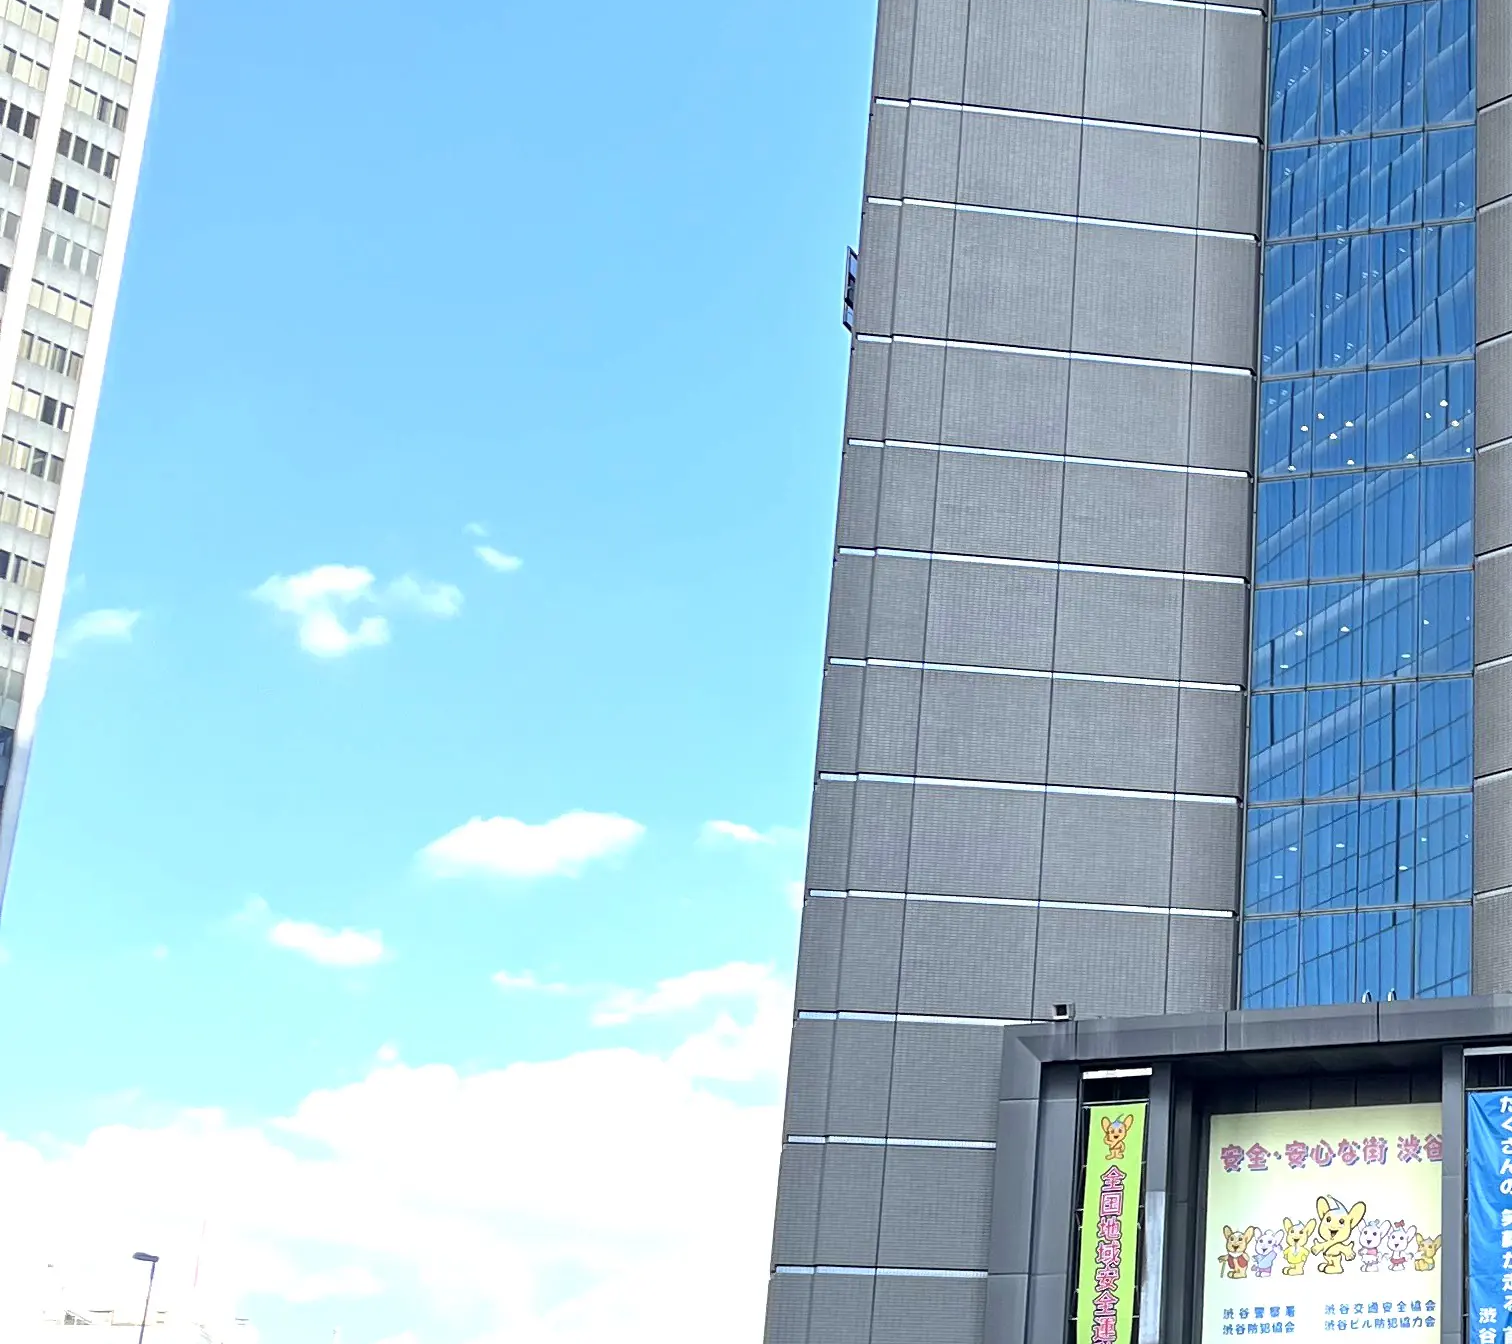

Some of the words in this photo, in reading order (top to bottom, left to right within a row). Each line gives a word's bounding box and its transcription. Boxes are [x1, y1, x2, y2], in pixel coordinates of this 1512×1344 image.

[1397, 1133, 1442, 1163] 渋谷
[1222, 1305, 1295, 1320] 渋谷警察署
[1324, 1299, 1436, 1316] 渋谷交通安全協会
[1222, 1320, 1295, 1336] 渋谷防犯協会
[1324, 1315, 1436, 1331] 渋谷ビル防犯協力会
